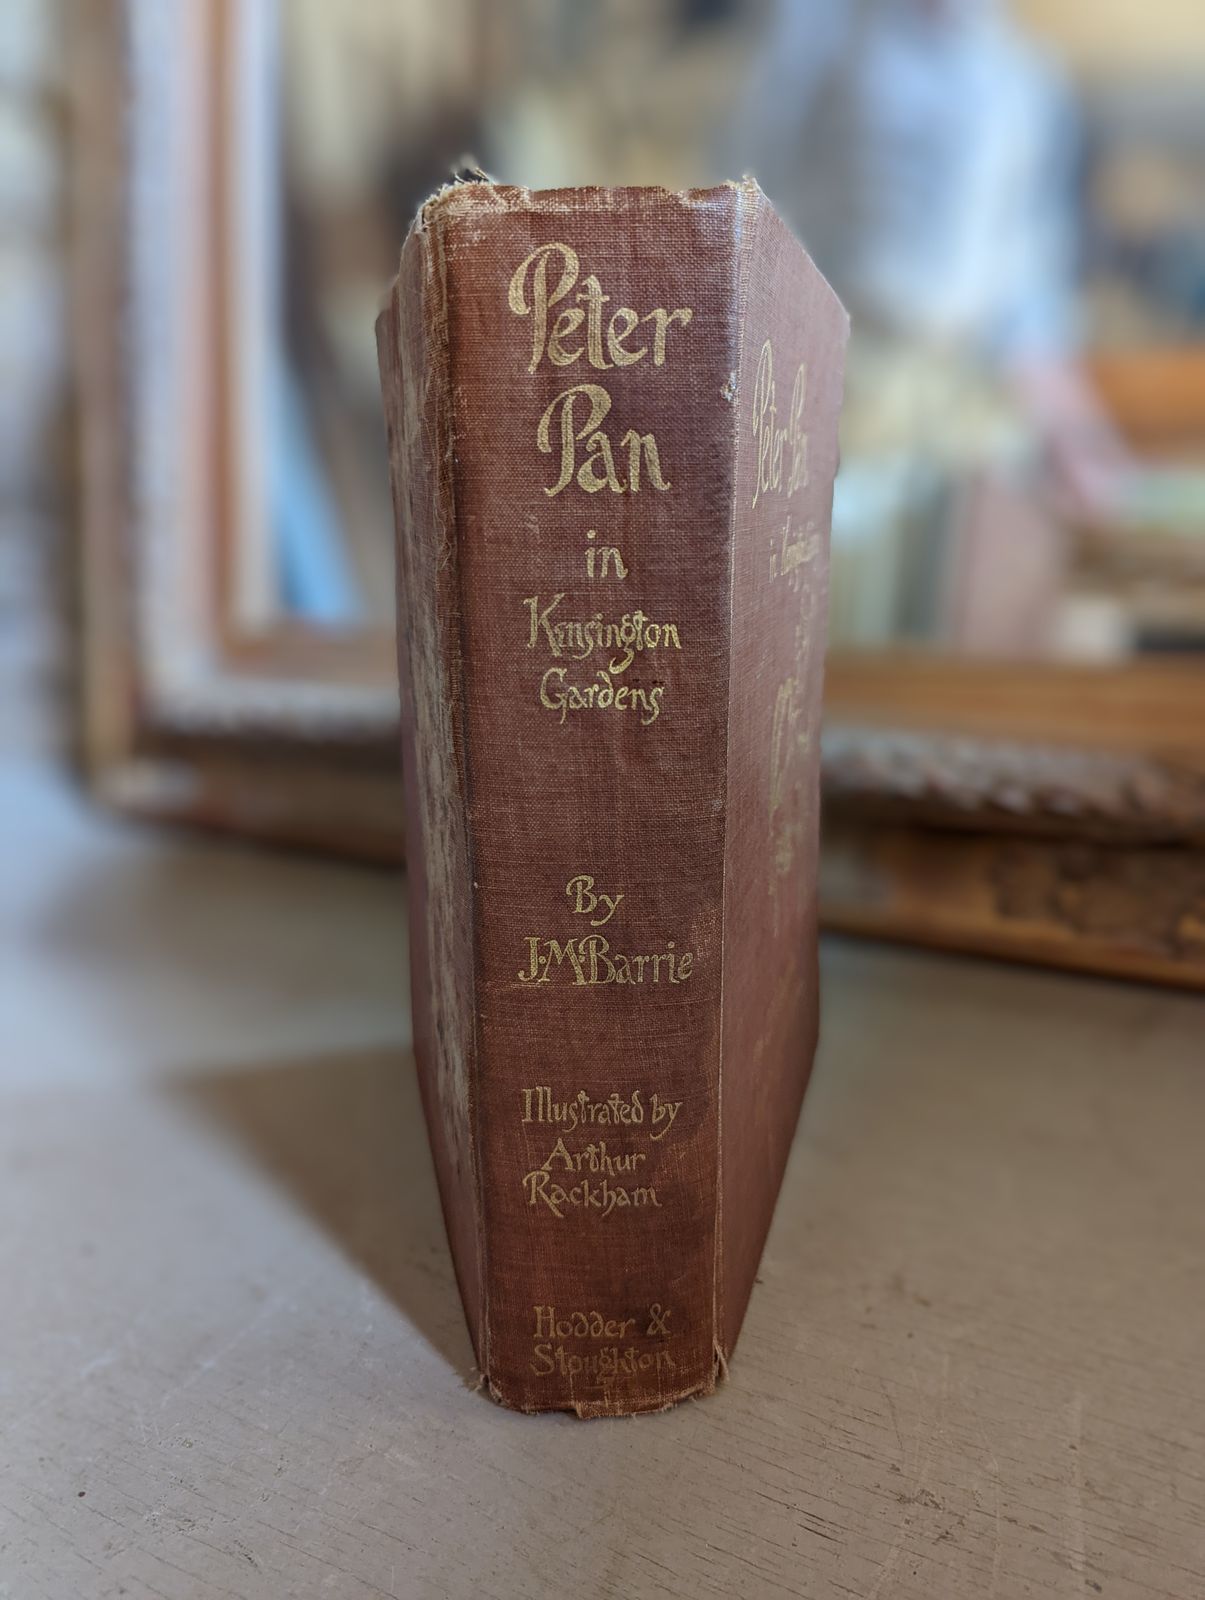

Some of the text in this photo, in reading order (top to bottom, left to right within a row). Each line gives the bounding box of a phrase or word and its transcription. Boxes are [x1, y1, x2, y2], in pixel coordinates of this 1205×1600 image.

[508, 242, 693, 374] Peter
[537, 384, 671, 497] Pan
[752, 340, 788, 509] Peter
[585, 529, 628, 579] in
[523, 593, 682, 674] Kensington
[540, 667, 664, 725] Gardens
[566, 875, 624, 926] By
[522, 1086, 683, 1140] Illustrated by
[541, 1137, 646, 1176] Arthur
[522, 1170, 662, 1218] Rackham
[533, 1303, 672, 1339] Hodder &
[530, 1343, 676, 1390] Stoughton
